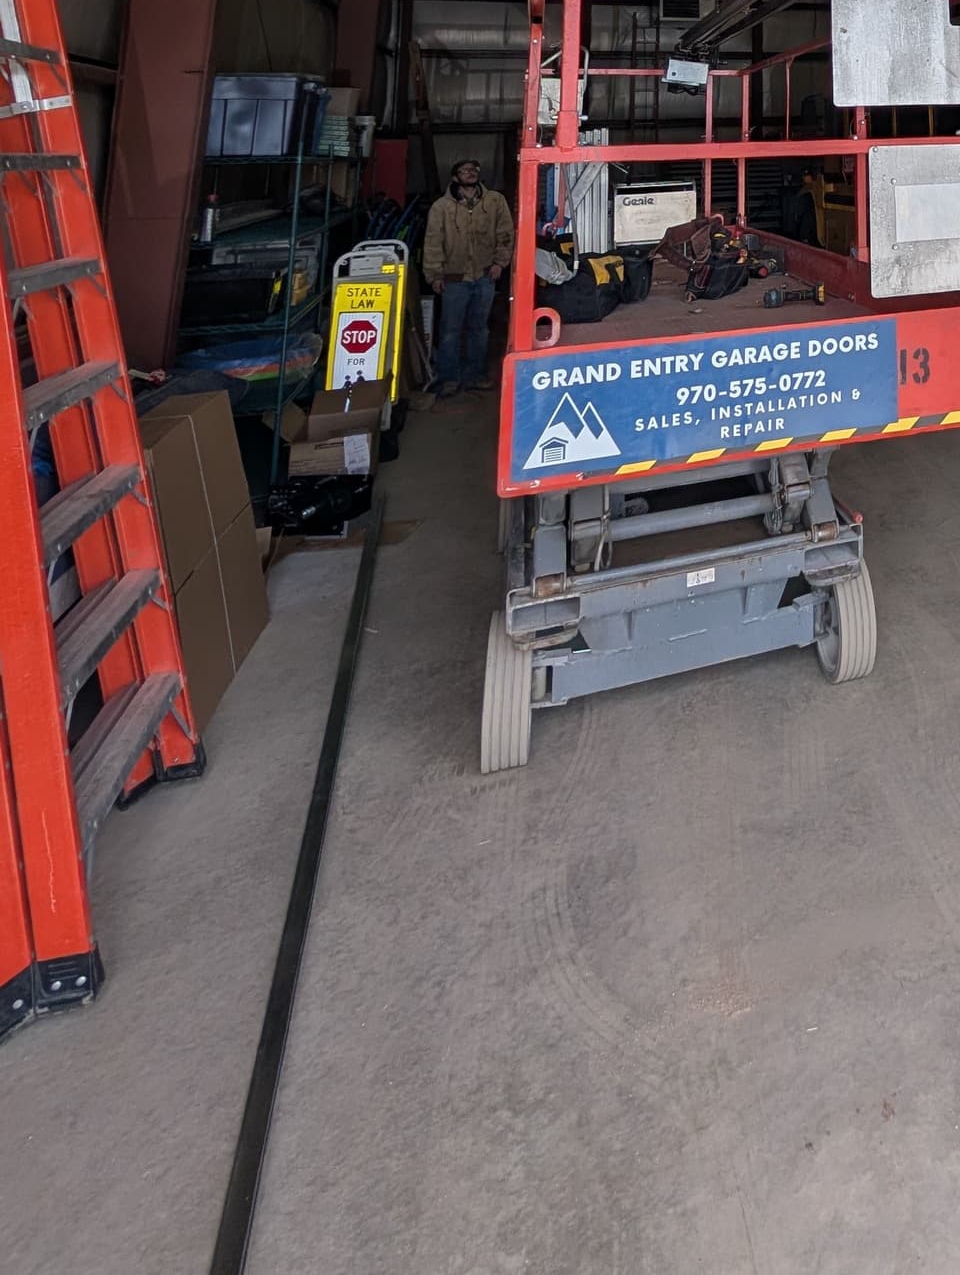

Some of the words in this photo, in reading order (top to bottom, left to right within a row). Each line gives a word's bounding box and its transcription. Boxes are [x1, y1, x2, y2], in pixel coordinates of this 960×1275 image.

[622, 196, 655, 207] Genie
[346, 287, 382, 298] STATE
[350, 299, 375, 310] LAW
[342, 330, 377, 345] STOP
[346, 358, 366, 367] FOR
[532, 362, 622, 390] GRAND
[630, 352, 704, 379] ENTRY
[711, 341, 801, 368] GARAGE
[808, 333, 879, 357] DOORS
[676, 369, 826, 406] 970-575-0772
[634, 411, 701, 432] SALES,
[711, 390, 842, 420] INSTALLATION
[851, 388, 861, 400] &
[720, 418, 785, 439] REPAIR
